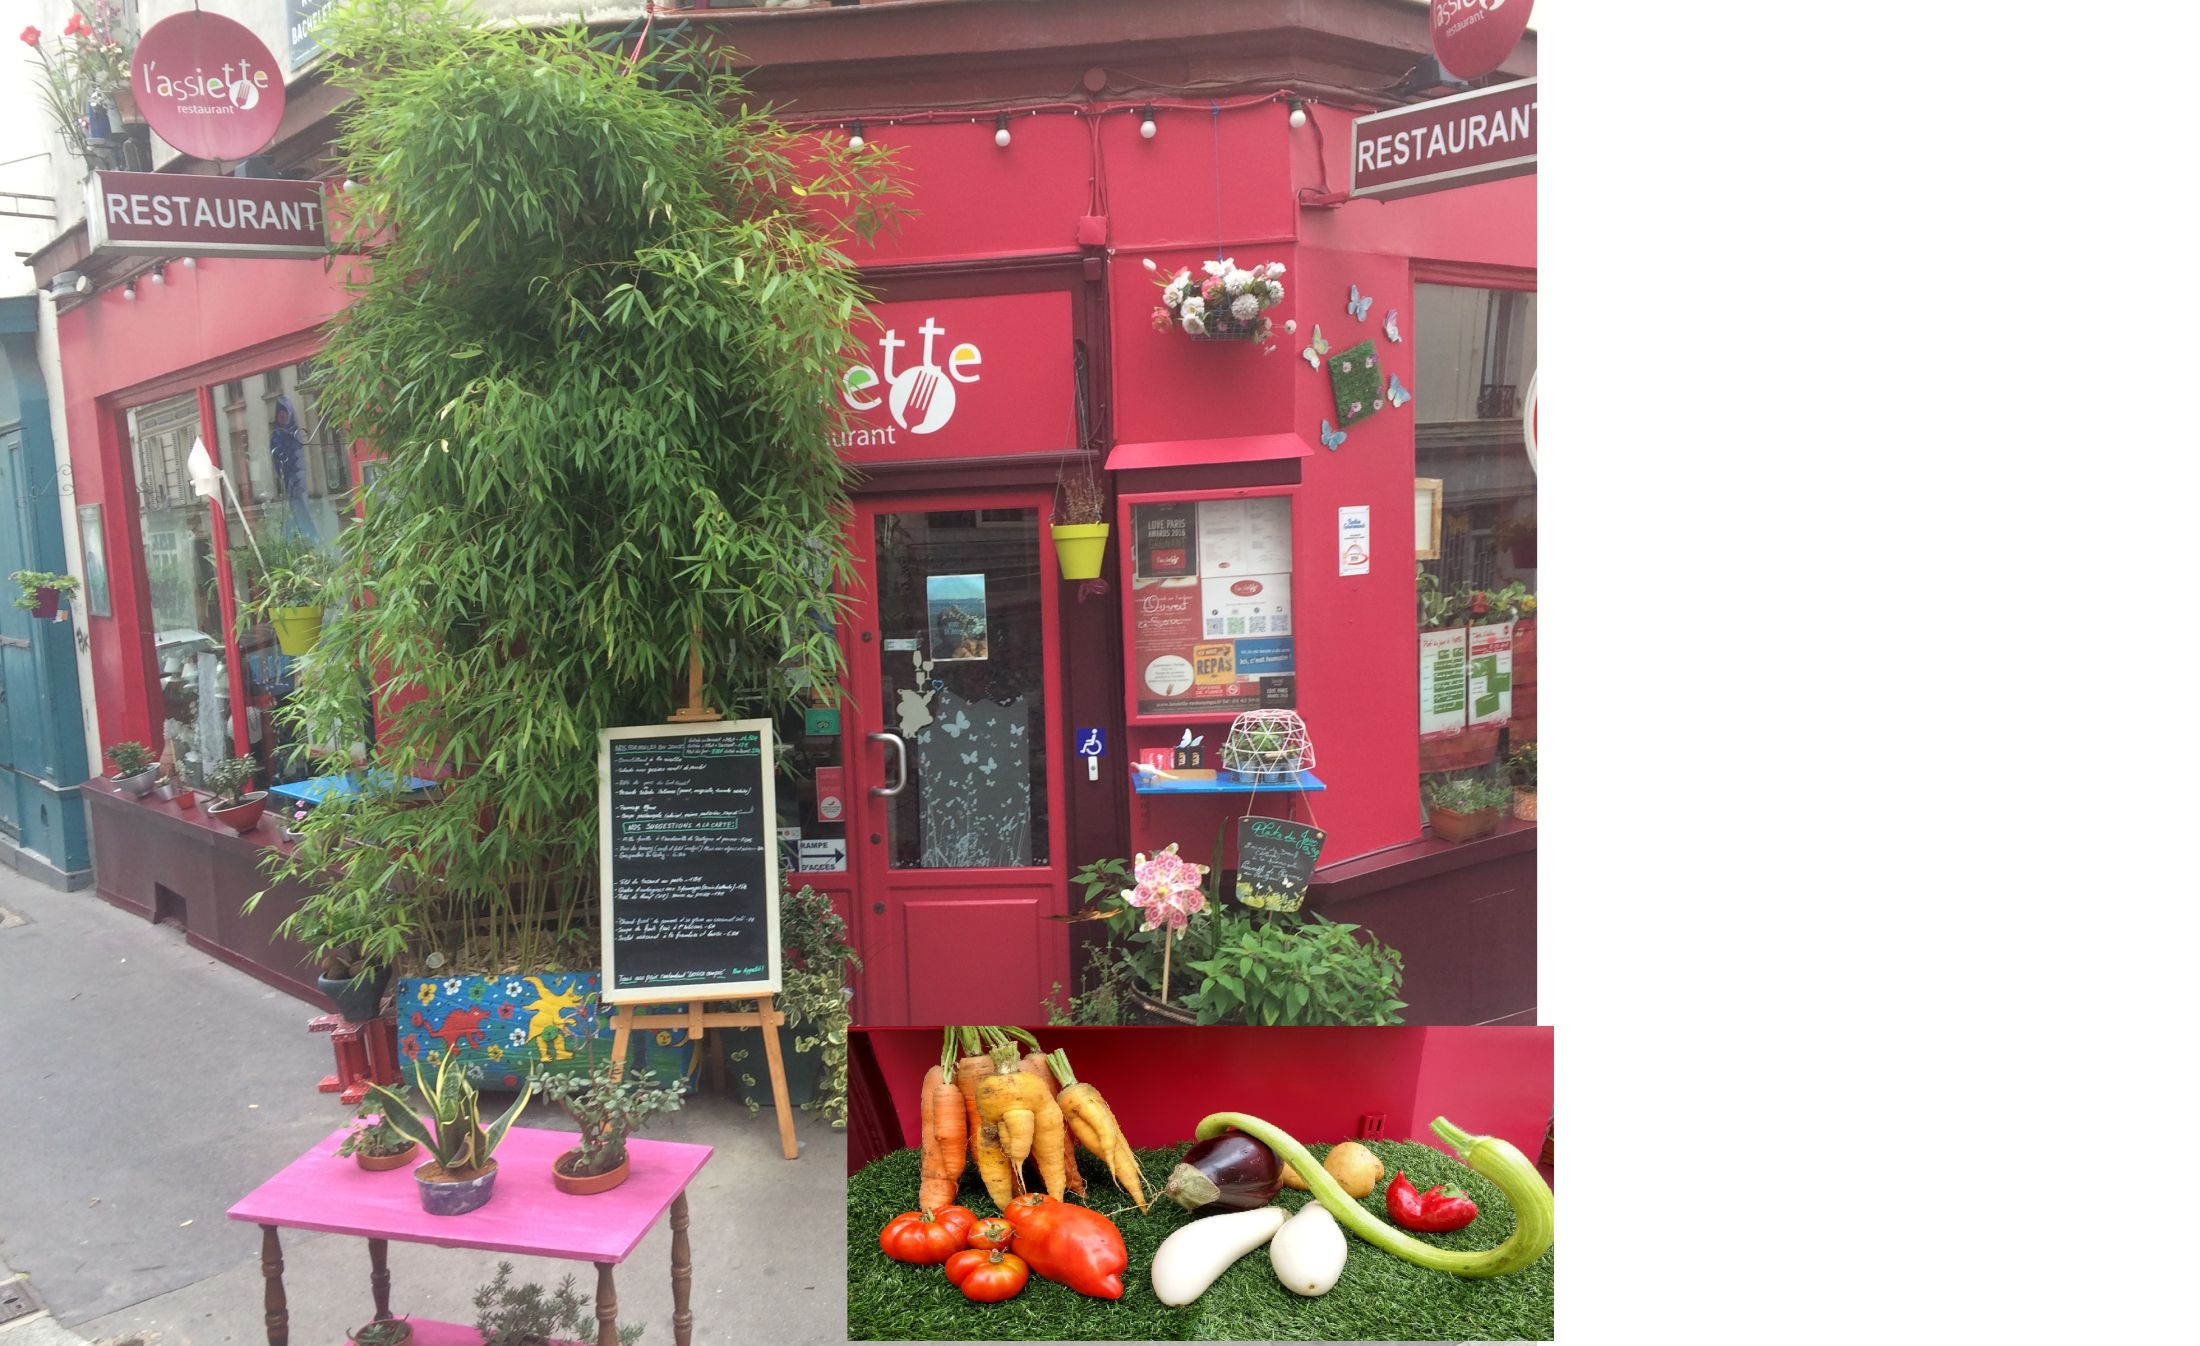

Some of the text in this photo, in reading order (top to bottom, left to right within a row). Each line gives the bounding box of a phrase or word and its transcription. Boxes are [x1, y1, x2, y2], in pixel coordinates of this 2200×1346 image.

[1446, 10, 1484, 37] restaurant
[143, 59, 268, 101] l'assiette
[177, 104, 234, 114] restaurant
[1358, 102, 1537, 173] RESTAURAN
[106, 193, 318, 231] RESTAURANT
[831, 425, 896, 447] urant
[1148, 519, 1185, 529] LOVE PARIS
[1197, 657, 1232, 675] REPAS
[645, 822, 692, 830] SUGGESTIONS
